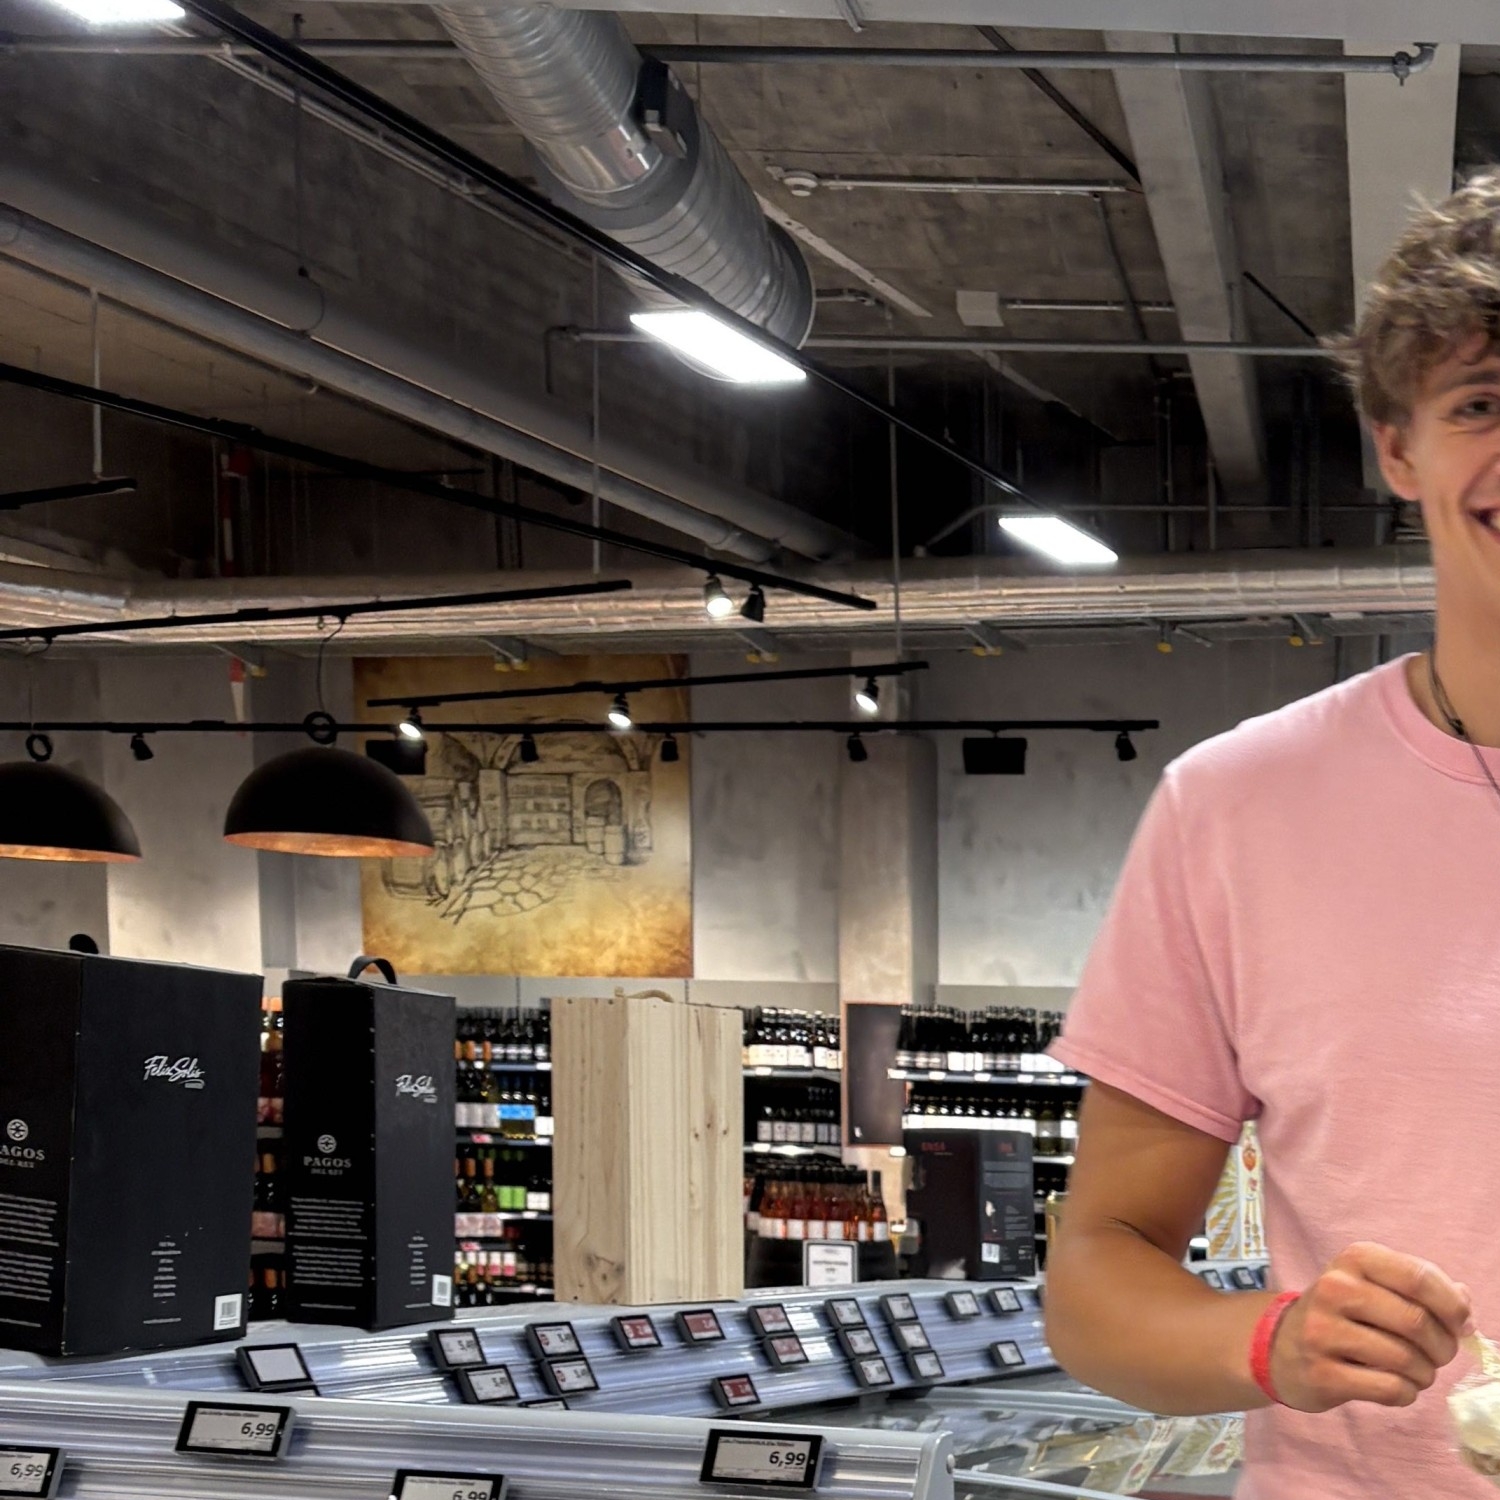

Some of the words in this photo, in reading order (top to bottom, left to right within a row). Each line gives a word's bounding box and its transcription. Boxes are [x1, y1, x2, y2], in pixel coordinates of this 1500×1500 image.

[0, 1145, 45, 1160] AGOS
[303, 1155, 352, 1168] PAGOS
[241, 1422, 276, 1438] 6,99
[768, 1451, 806, 1467] 6,99
[10, 1463, 44, 1479] 6,99
